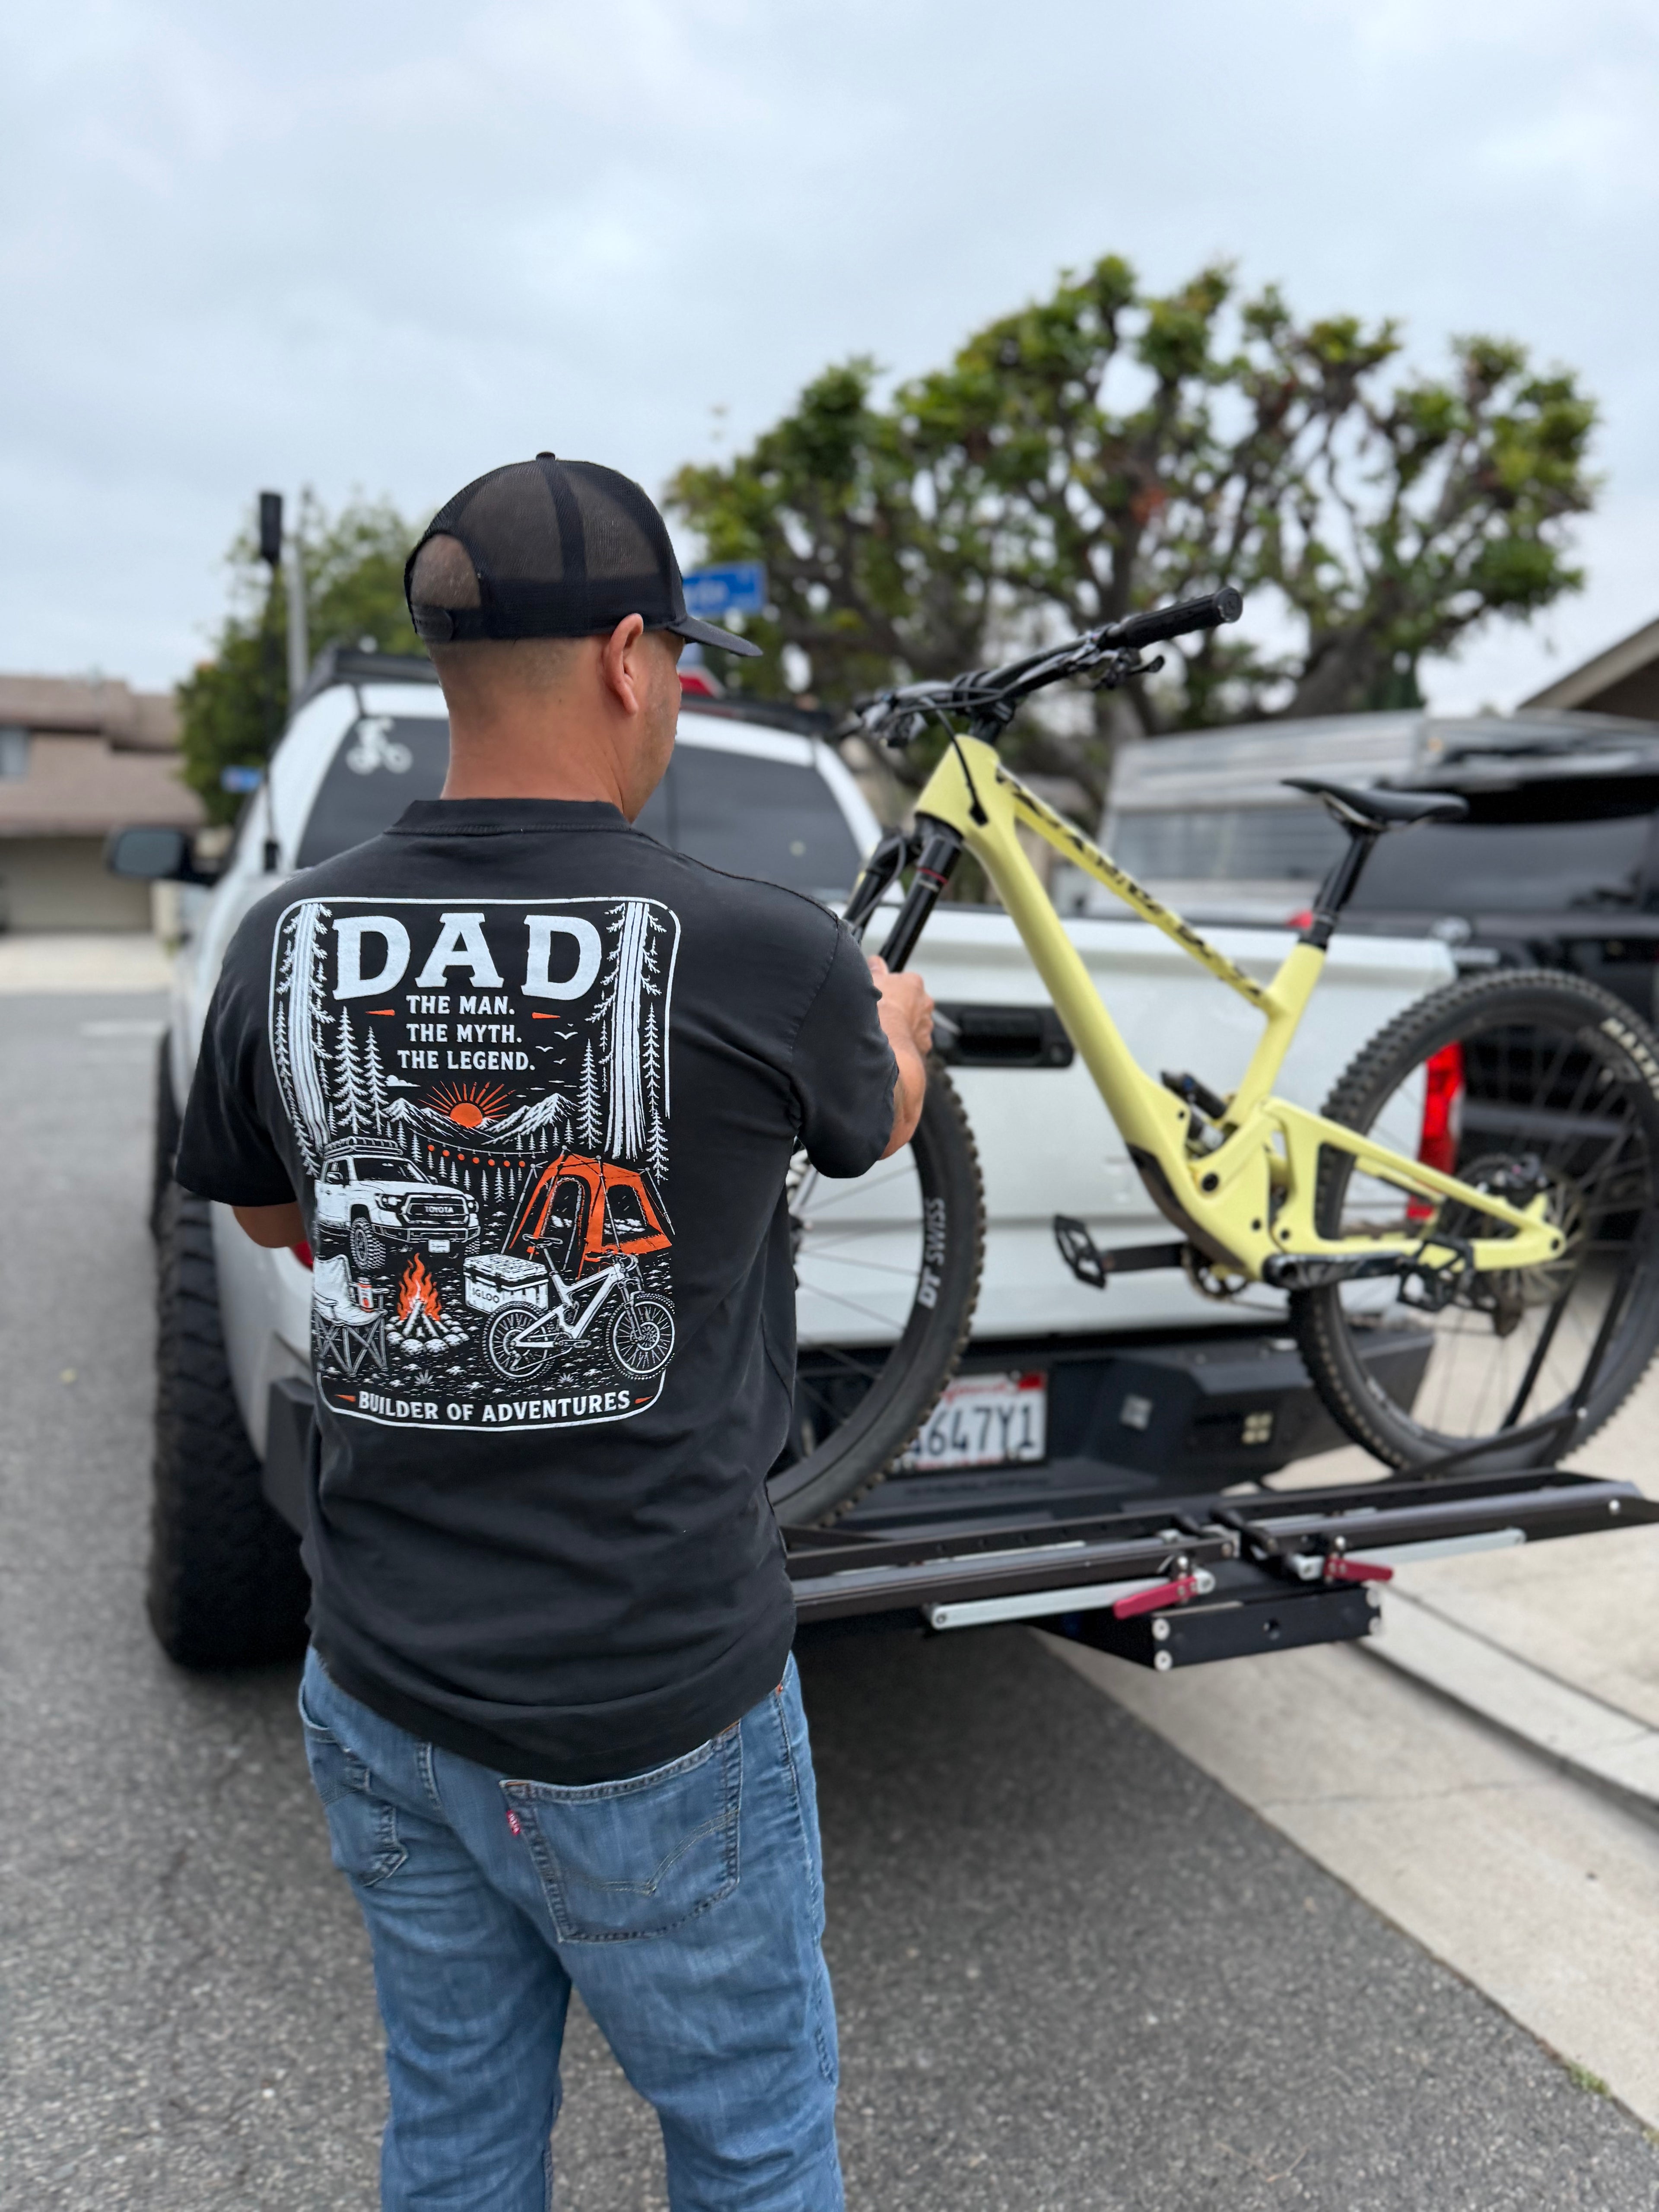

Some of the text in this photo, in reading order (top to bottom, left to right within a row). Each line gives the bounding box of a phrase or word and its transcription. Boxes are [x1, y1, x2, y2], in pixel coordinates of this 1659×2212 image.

[331, 912, 602, 1001] DAD
[406, 995, 515, 1015] THE MAN.
[406, 1023, 522, 1043] THE MYTH.
[397, 1050, 536, 1071] THE LEGEND.
[917, 1198, 946, 1309] DT SWISS
[472, 1287, 500, 1303] IGLOO
[359, 1390, 630, 1422] BUILDER OF ADVENTURES
